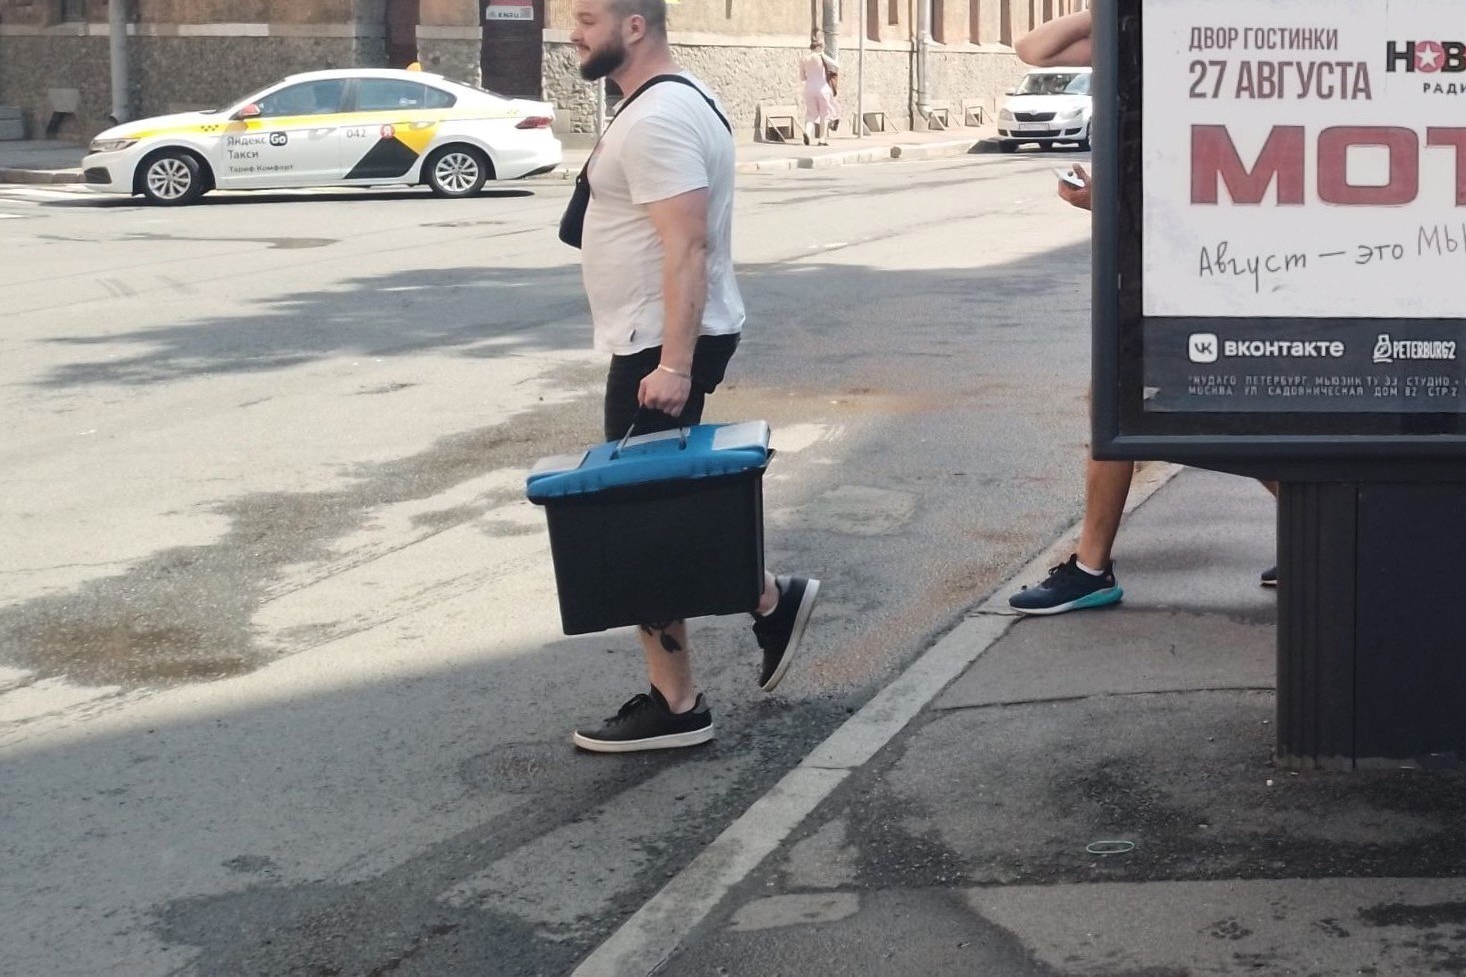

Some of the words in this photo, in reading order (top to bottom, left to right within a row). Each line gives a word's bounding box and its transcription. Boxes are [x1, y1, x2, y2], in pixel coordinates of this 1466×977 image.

[1189, 26, 1239, 52] ДВОР
[1243, 26, 1339, 51] ГОСТИНКИ
[1189, 60, 1228, 100] 27
[1234, 61, 1373, 101] АВГУСТА
[270, 133, 286, 144] Go
[227, 150, 259, 160] Такси
[1199, 240, 1307, 293] Август
[1355, 244, 1405, 265] это
